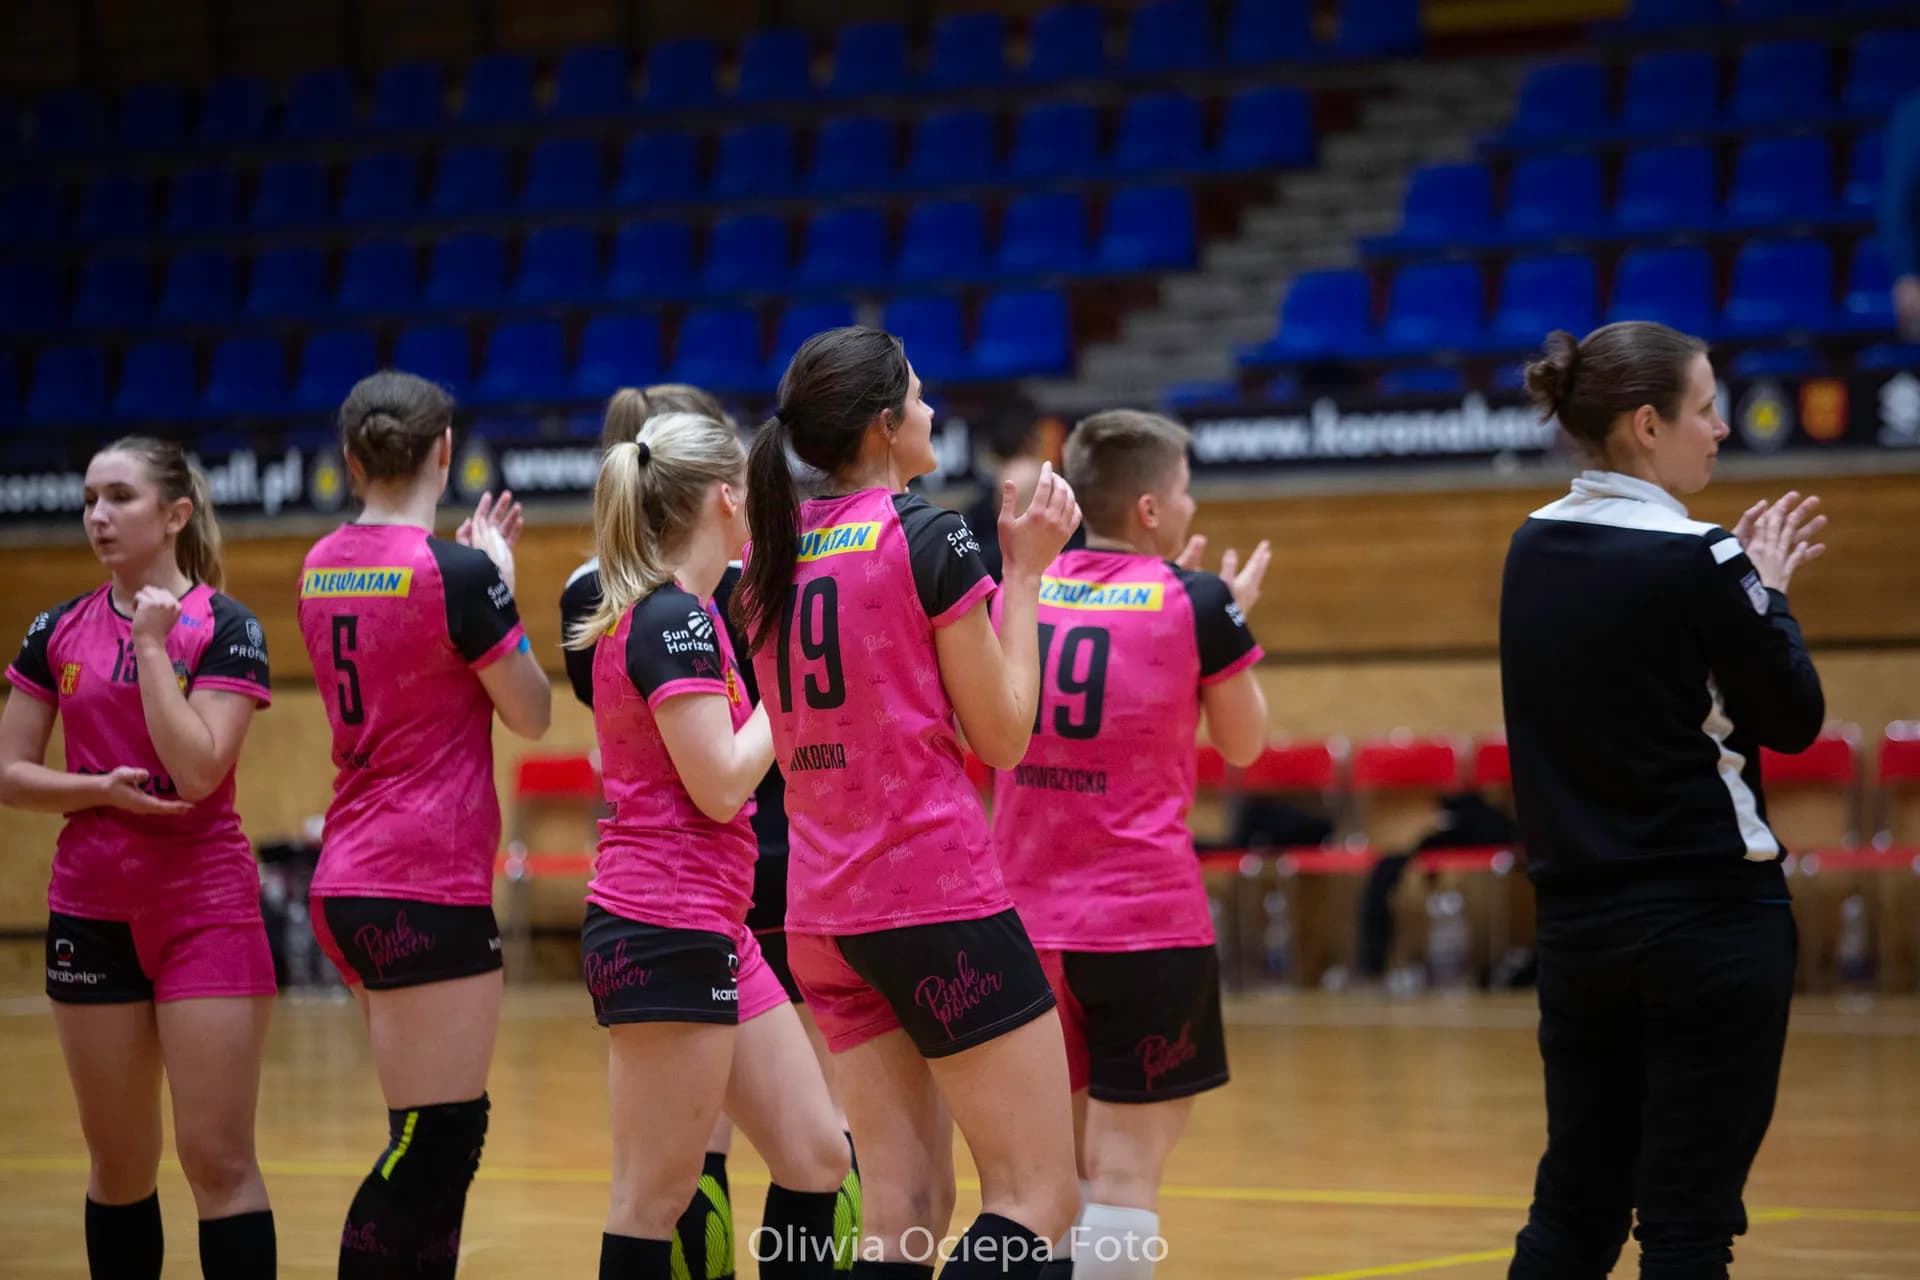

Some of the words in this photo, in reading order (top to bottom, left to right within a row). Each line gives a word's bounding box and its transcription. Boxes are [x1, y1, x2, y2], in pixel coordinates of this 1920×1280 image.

[662, 629, 690, 642] Sun
[666, 639, 714, 655] Horizon
[332, 615, 364, 725] 5
[584, 938, 632, 990] Pink
[914, 949, 978, 1020] Pink
